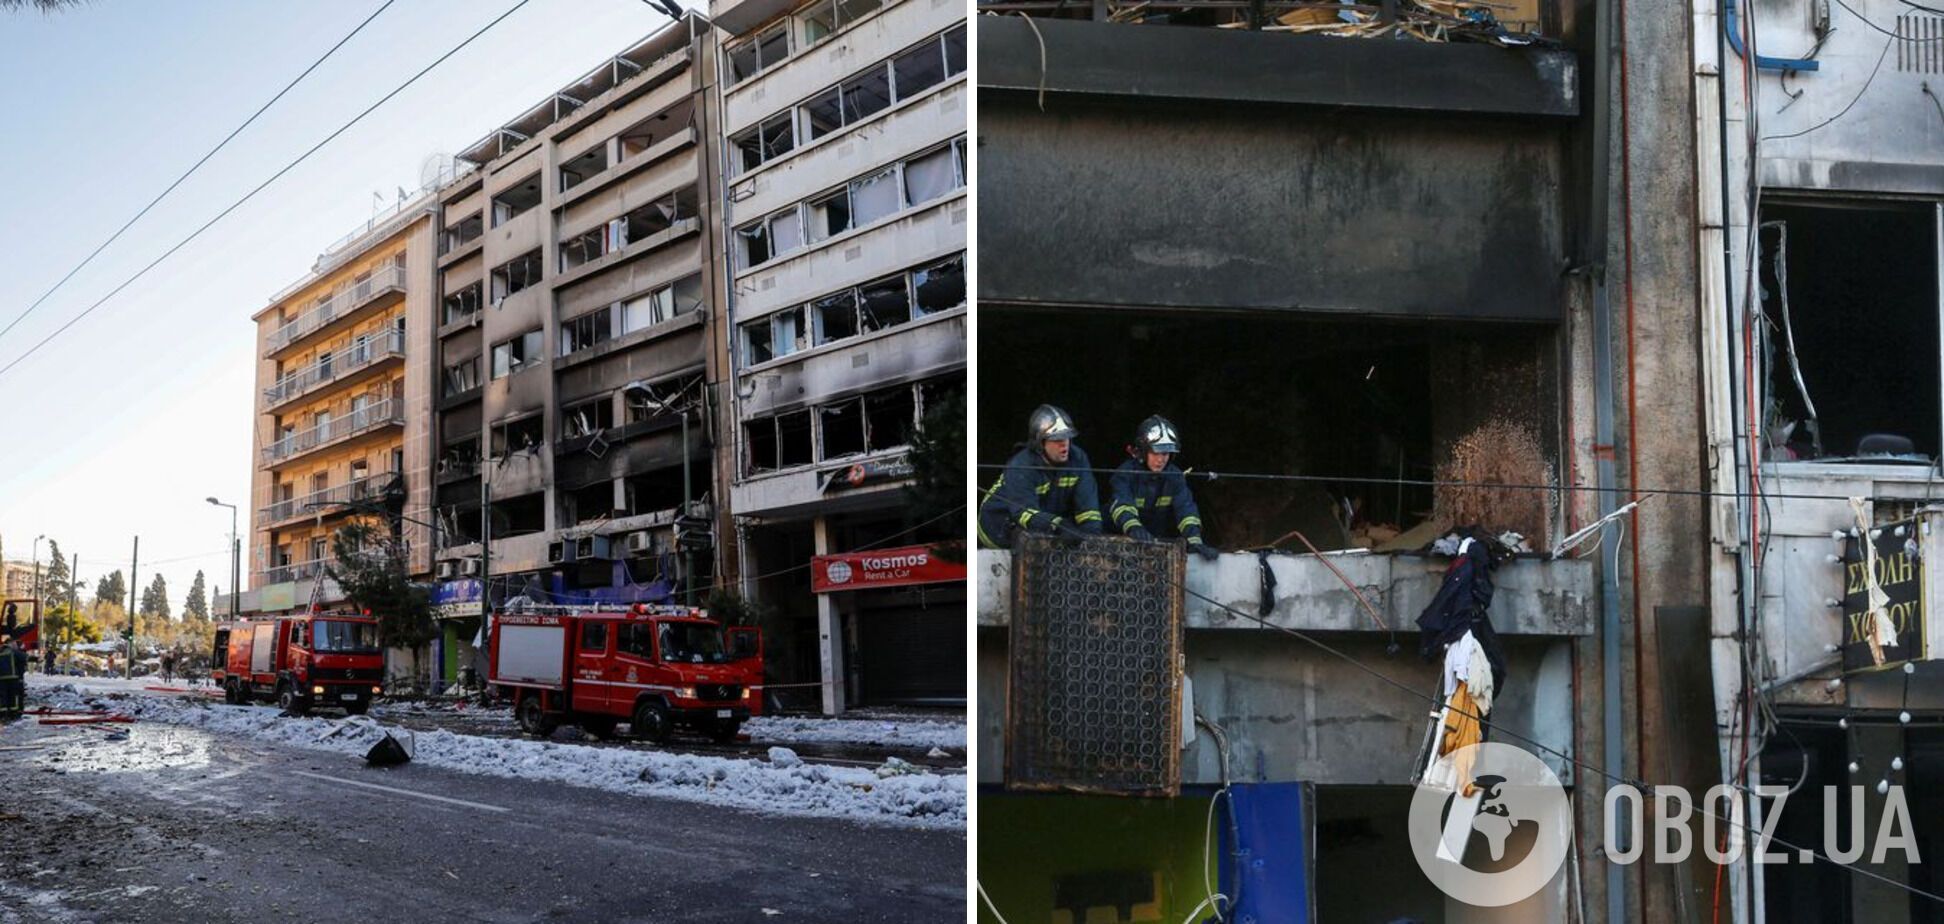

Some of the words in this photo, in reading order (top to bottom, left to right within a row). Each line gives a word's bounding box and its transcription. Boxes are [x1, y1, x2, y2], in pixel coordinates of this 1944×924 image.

[862, 553, 929, 571] Kosmos
[864, 570, 886, 581] Rent
[887, 571, 894, 579] a
[894, 568, 910, 578] Car
[1847, 551, 1914, 595] ΣΧΟΛΗ
